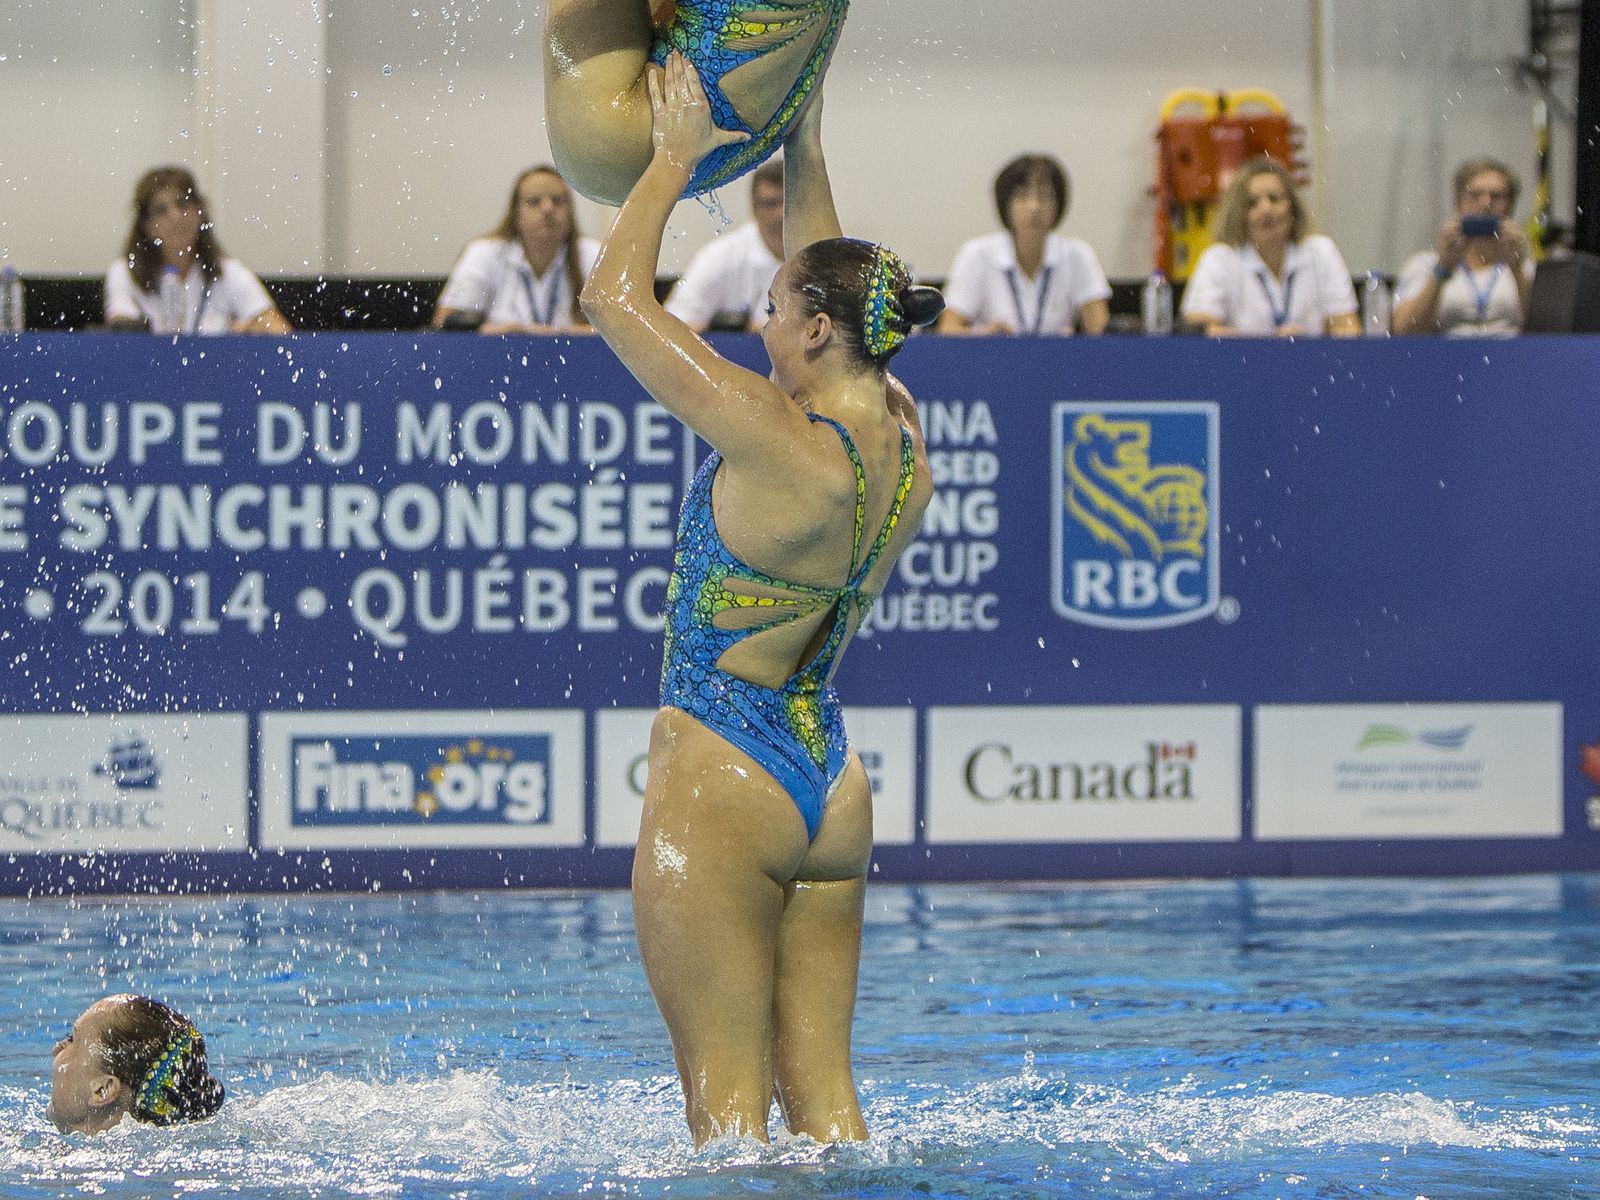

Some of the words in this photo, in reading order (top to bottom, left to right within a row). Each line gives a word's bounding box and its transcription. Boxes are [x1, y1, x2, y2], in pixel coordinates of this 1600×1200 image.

[0, 401, 224, 466] OUPE
[257, 401, 362, 466] DU
[398, 401, 675, 465] MONDE
[58, 467, 675, 551] SYNCHRONISÉE
[900, 541, 1000, 588] CUP
[1073, 558, 1203, 610] RBC
[82, 571, 271, 636] 2014
[350, 554, 670, 647] QUÉBEC
[961, 740, 1196, 806] Canada
